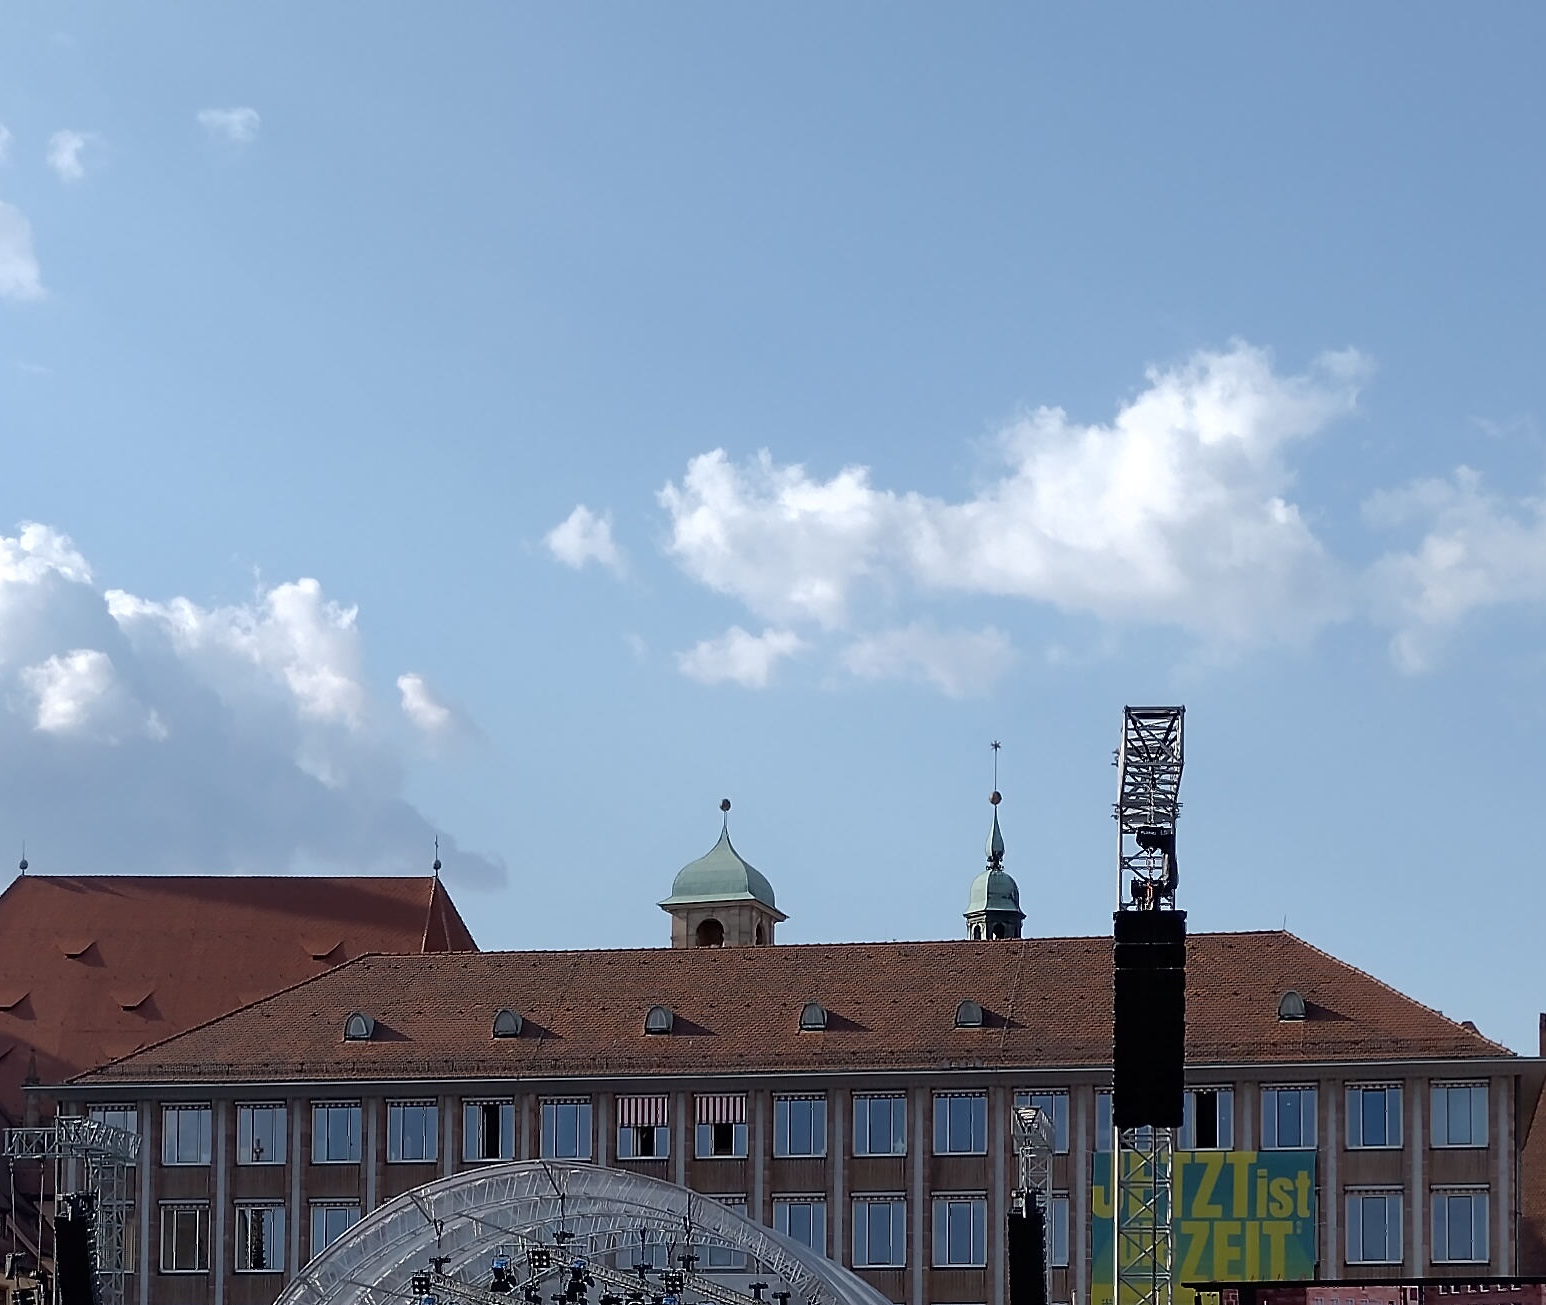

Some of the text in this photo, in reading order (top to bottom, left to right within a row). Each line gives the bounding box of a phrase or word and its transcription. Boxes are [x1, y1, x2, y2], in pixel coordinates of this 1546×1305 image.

[1092, 1152, 1311, 1219] JETZT ist
[1179, 1221, 1294, 1281] ZEIT
